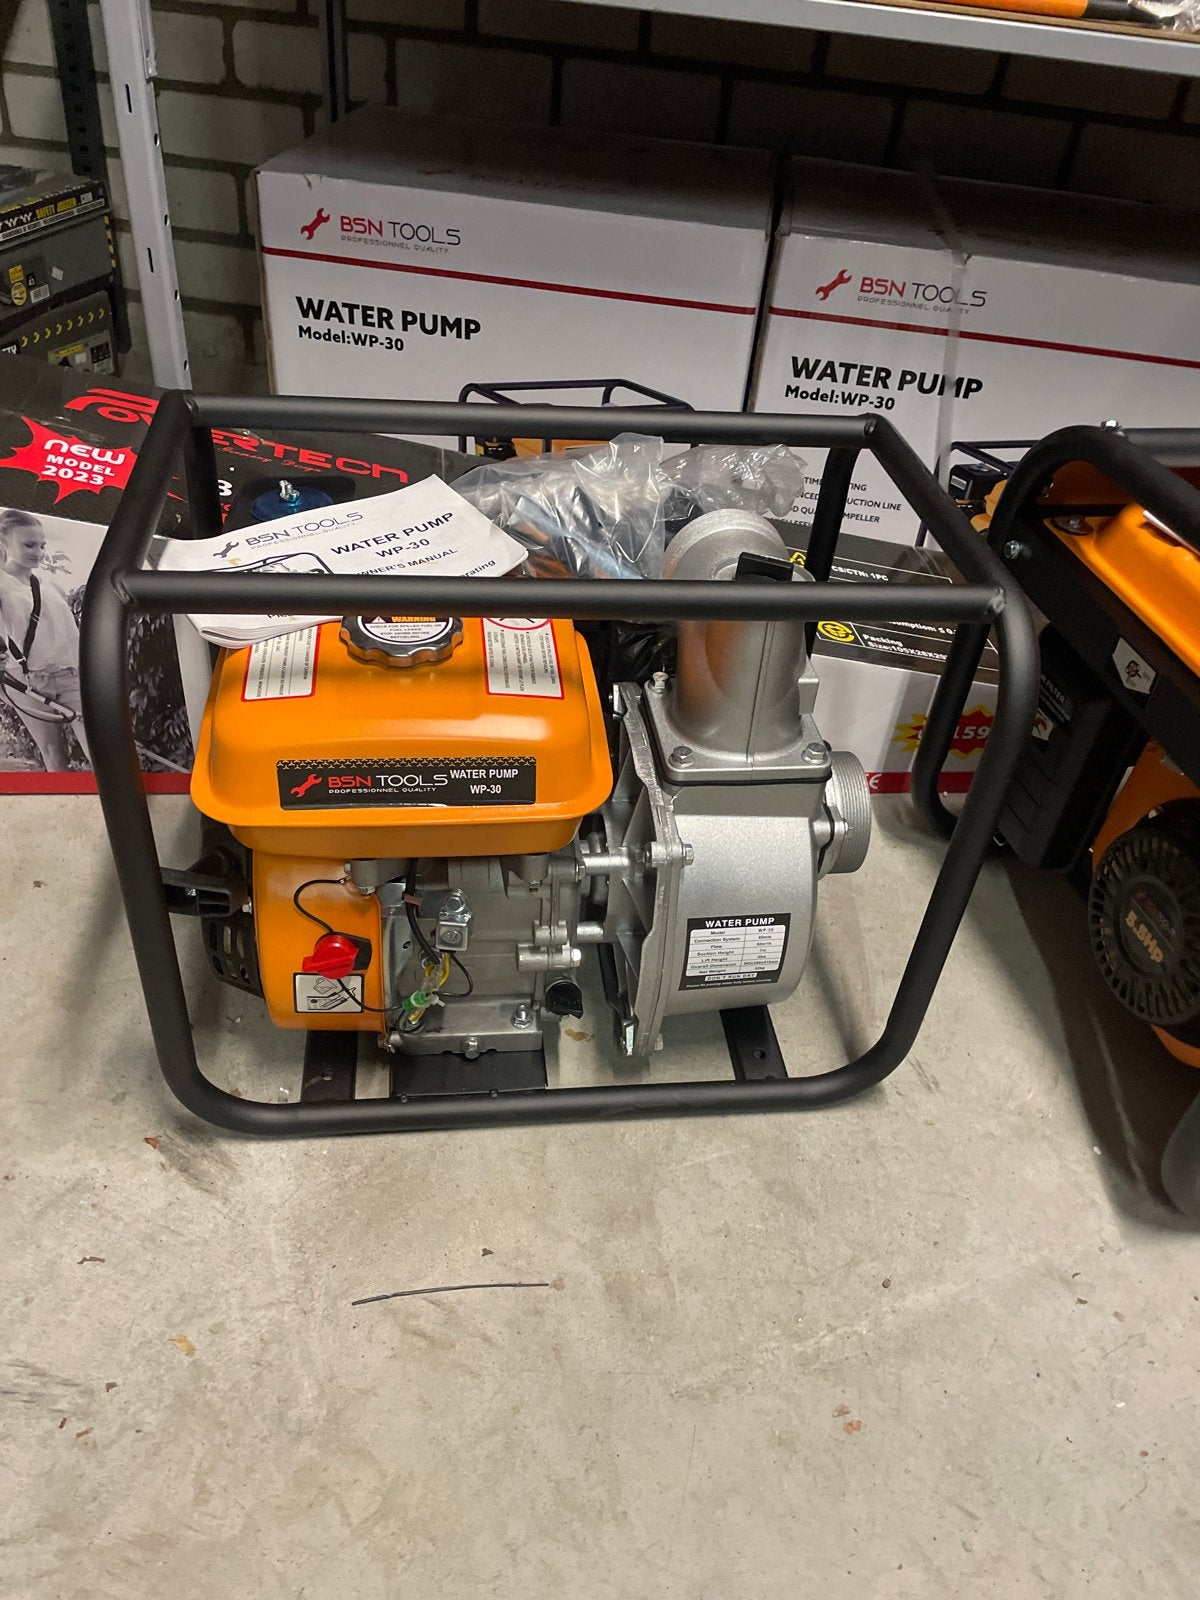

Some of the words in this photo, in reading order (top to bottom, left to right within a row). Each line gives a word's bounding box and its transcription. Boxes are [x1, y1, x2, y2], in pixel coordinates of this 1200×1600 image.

[340, 215, 383, 237] BSN
[387, 221, 461, 246] TOOLS
[413, 244, 449, 254] QUALITY
[860, 276, 907, 297] BSN
[912, 282, 988, 307] TOOLS
[295, 296, 395, 330] WATER
[401, 310, 482, 340] PUMP
[933, 305, 970, 315] QUATY
[298, 324, 405, 351] Model:WP-30
[791, 356, 893, 389] WATER
[897, 370, 984, 400] PUMP
[784, 384, 896, 410] Model:WP-30
[41, 464, 104, 486] 2023
[46, 454, 115, 477] MODEL
[846, 497, 881, 509] UCTION
[882, 502, 902, 511] LINE
[843, 512, 880, 523] MPELLER
[245, 529, 291, 546] BSN
[292, 512, 363, 534] TOOLS
[330, 532, 400, 555] WATER
[402, 512, 453, 536] PUMP
[375, 538, 430, 558] WP-30
[357, 562, 406, 576] WNER'S
[408, 548, 458, 567] MANUAL
[459, 559, 496, 577] rating
[862, 633, 904, 648] Packing
[328, 775, 371, 788] BSN
[376, 774, 448, 787] TOOLS
[449, 768, 487, 780] WATER
[488, 768, 519, 779] PUMP
[470, 784, 502, 795] WP-30
[705, 918, 742, 928] WATER
[745, 917, 775, 926] PUMP
